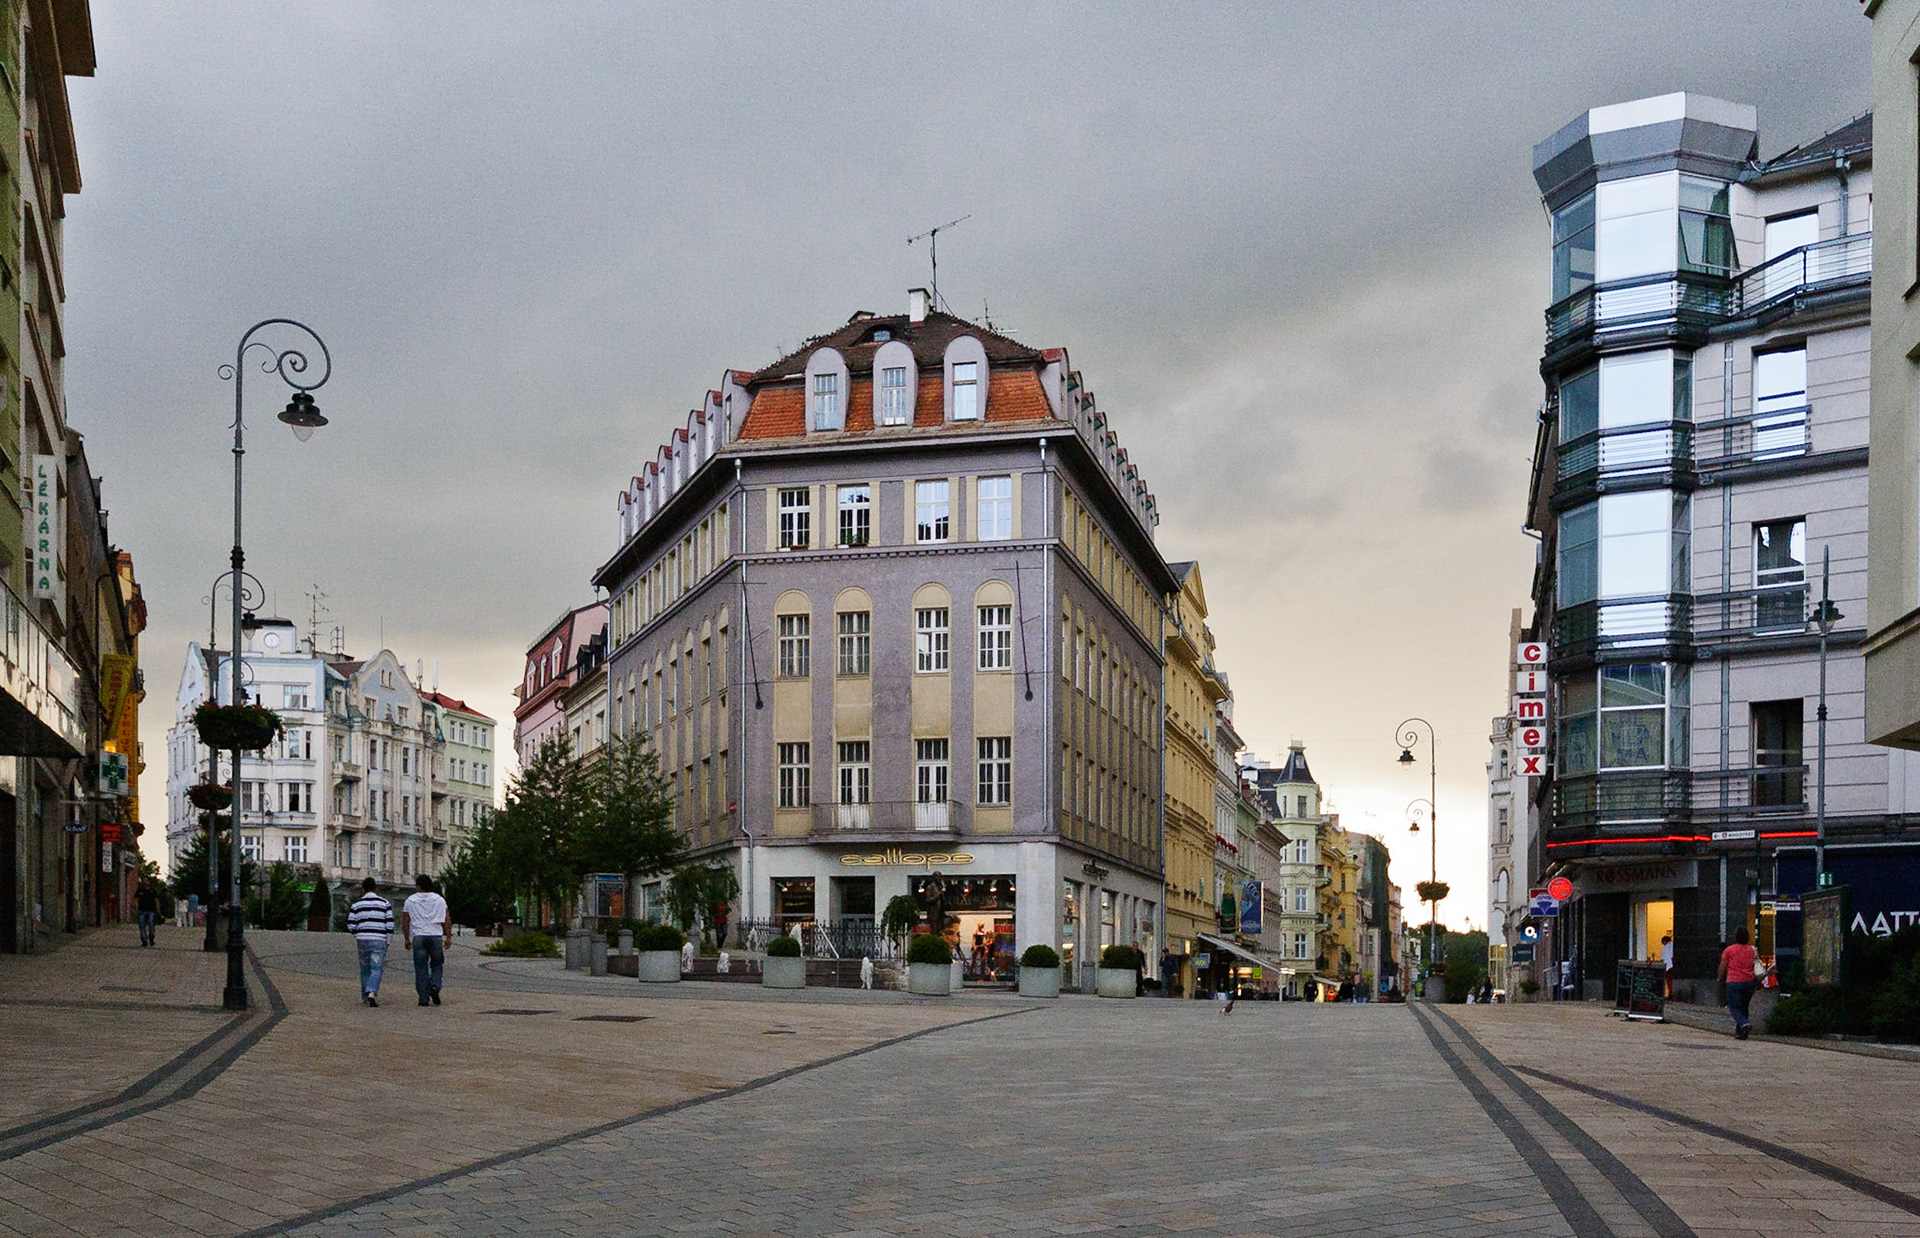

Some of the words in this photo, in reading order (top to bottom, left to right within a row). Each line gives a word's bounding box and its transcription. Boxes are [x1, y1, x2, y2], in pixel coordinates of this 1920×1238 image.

[38, 464, 50, 590] LÉKÁRNA
[1519, 645, 1543, 774] cimex
[840, 848, 976, 870] calliope
[1596, 864, 1678, 884] ROSSMANN
